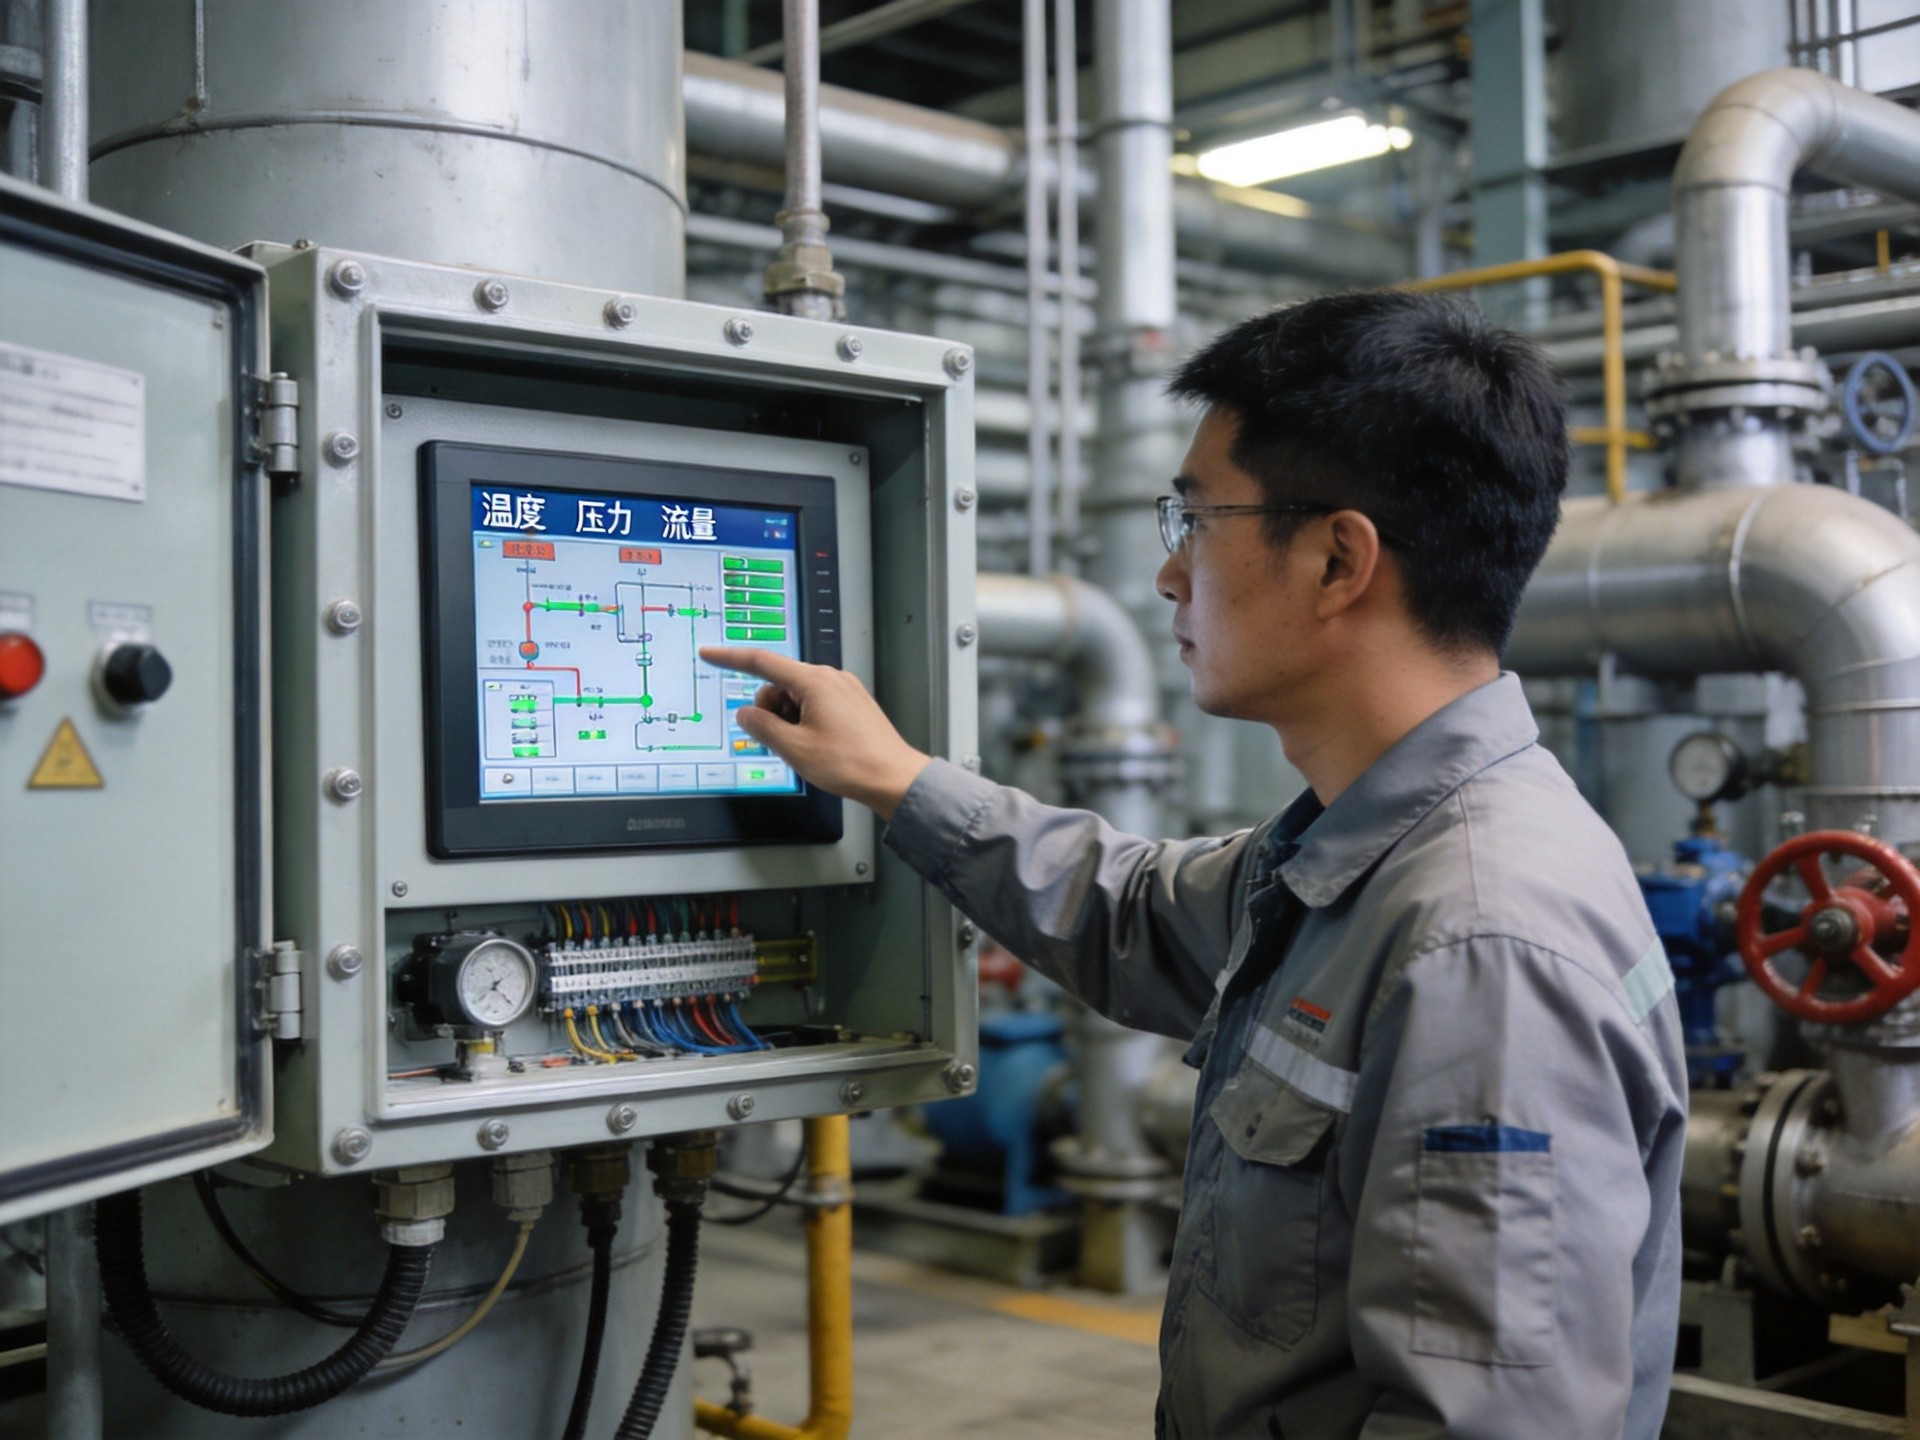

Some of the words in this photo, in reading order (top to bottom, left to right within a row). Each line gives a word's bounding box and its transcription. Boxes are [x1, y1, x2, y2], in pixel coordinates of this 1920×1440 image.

[482, 492, 546, 531] 温度
[576, 500, 631, 535] 压力
[662, 504, 717, 541] 流量
